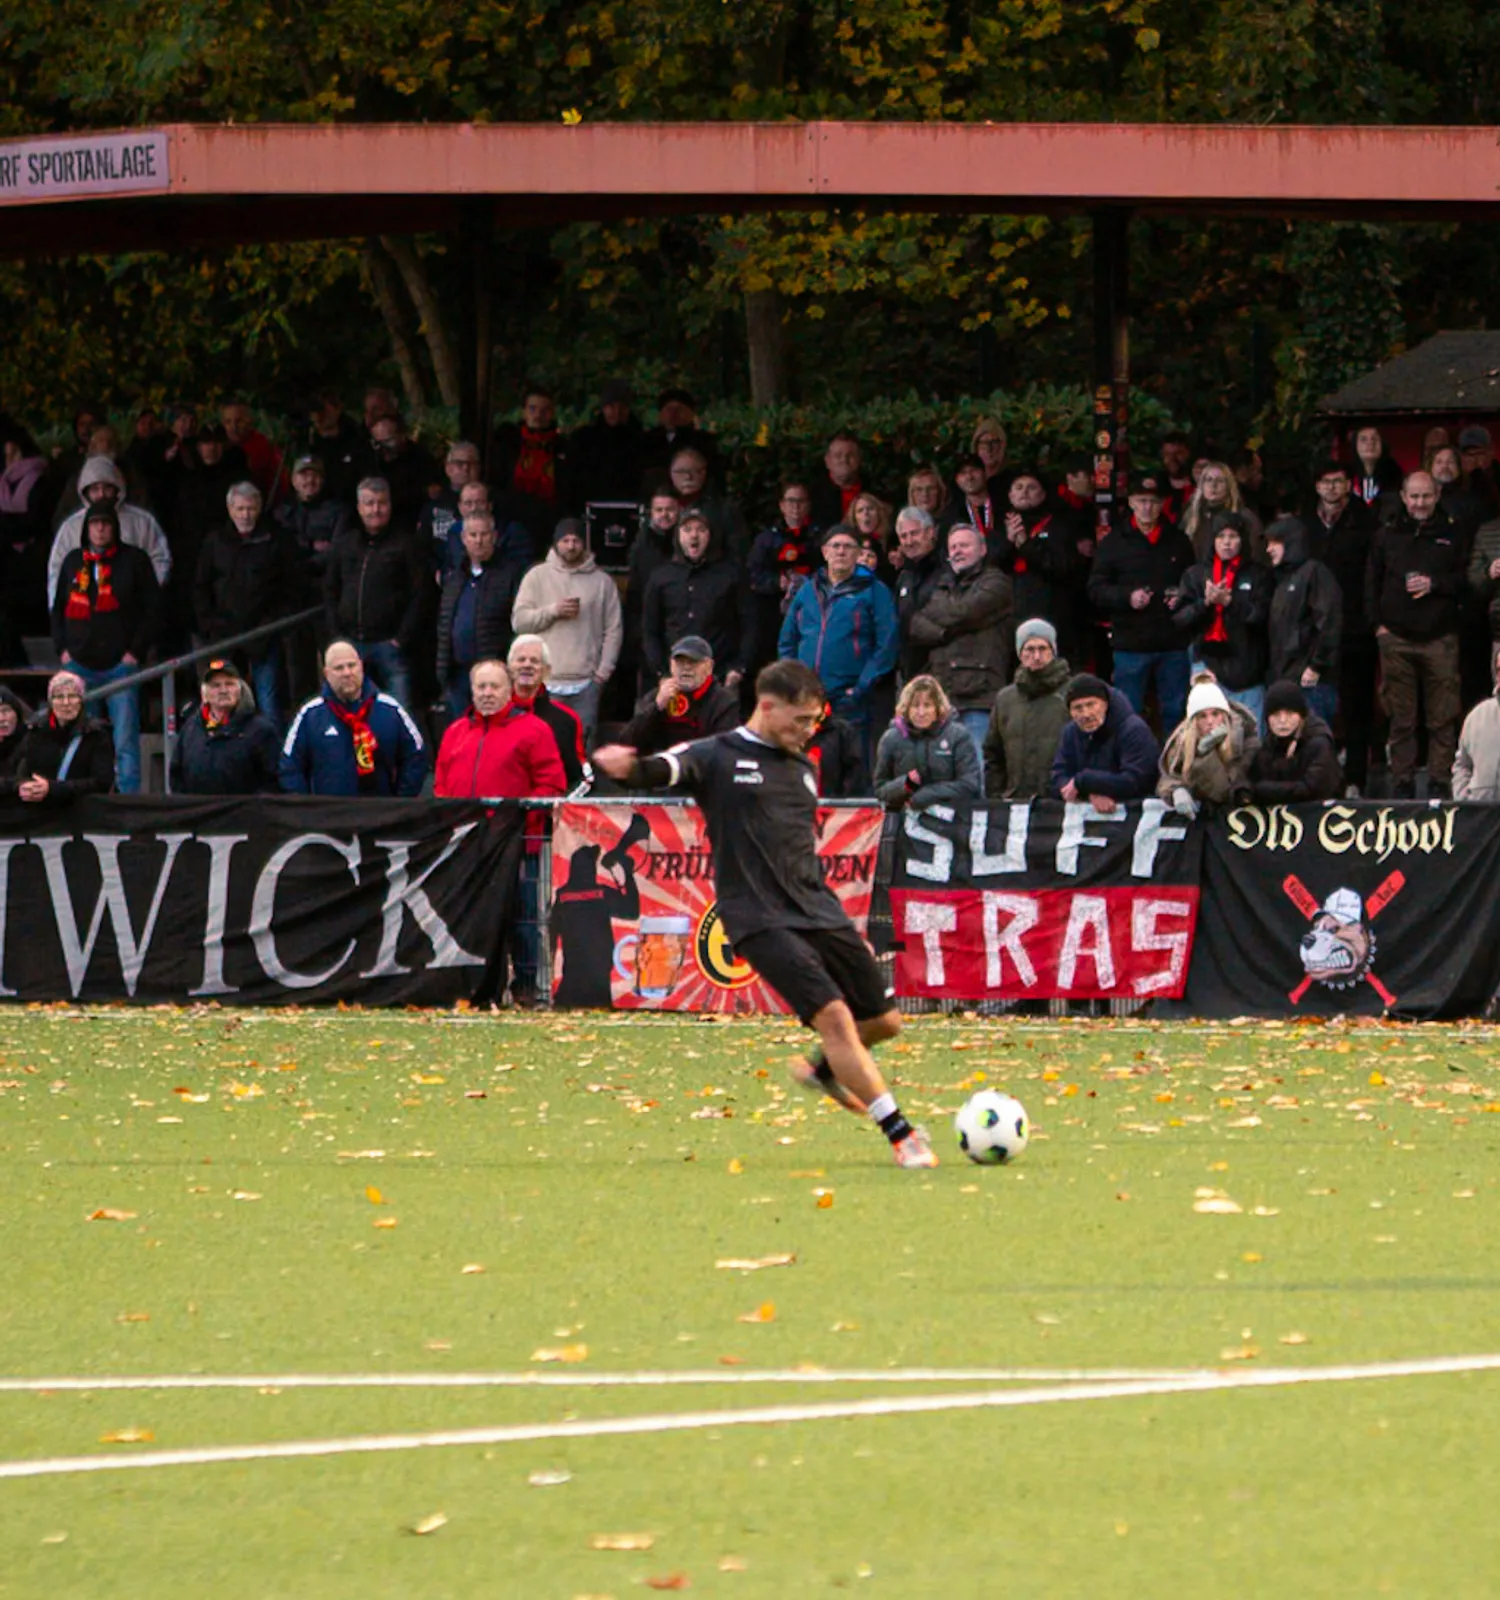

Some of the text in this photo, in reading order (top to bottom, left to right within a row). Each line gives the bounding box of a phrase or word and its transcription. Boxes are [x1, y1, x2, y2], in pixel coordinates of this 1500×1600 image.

[28, 144, 156, 185] SPORTANLAGE
[903, 798, 1187, 883] SUFF
[1227, 804, 1460, 864] Old School
[904, 890, 1190, 994] TRAS
